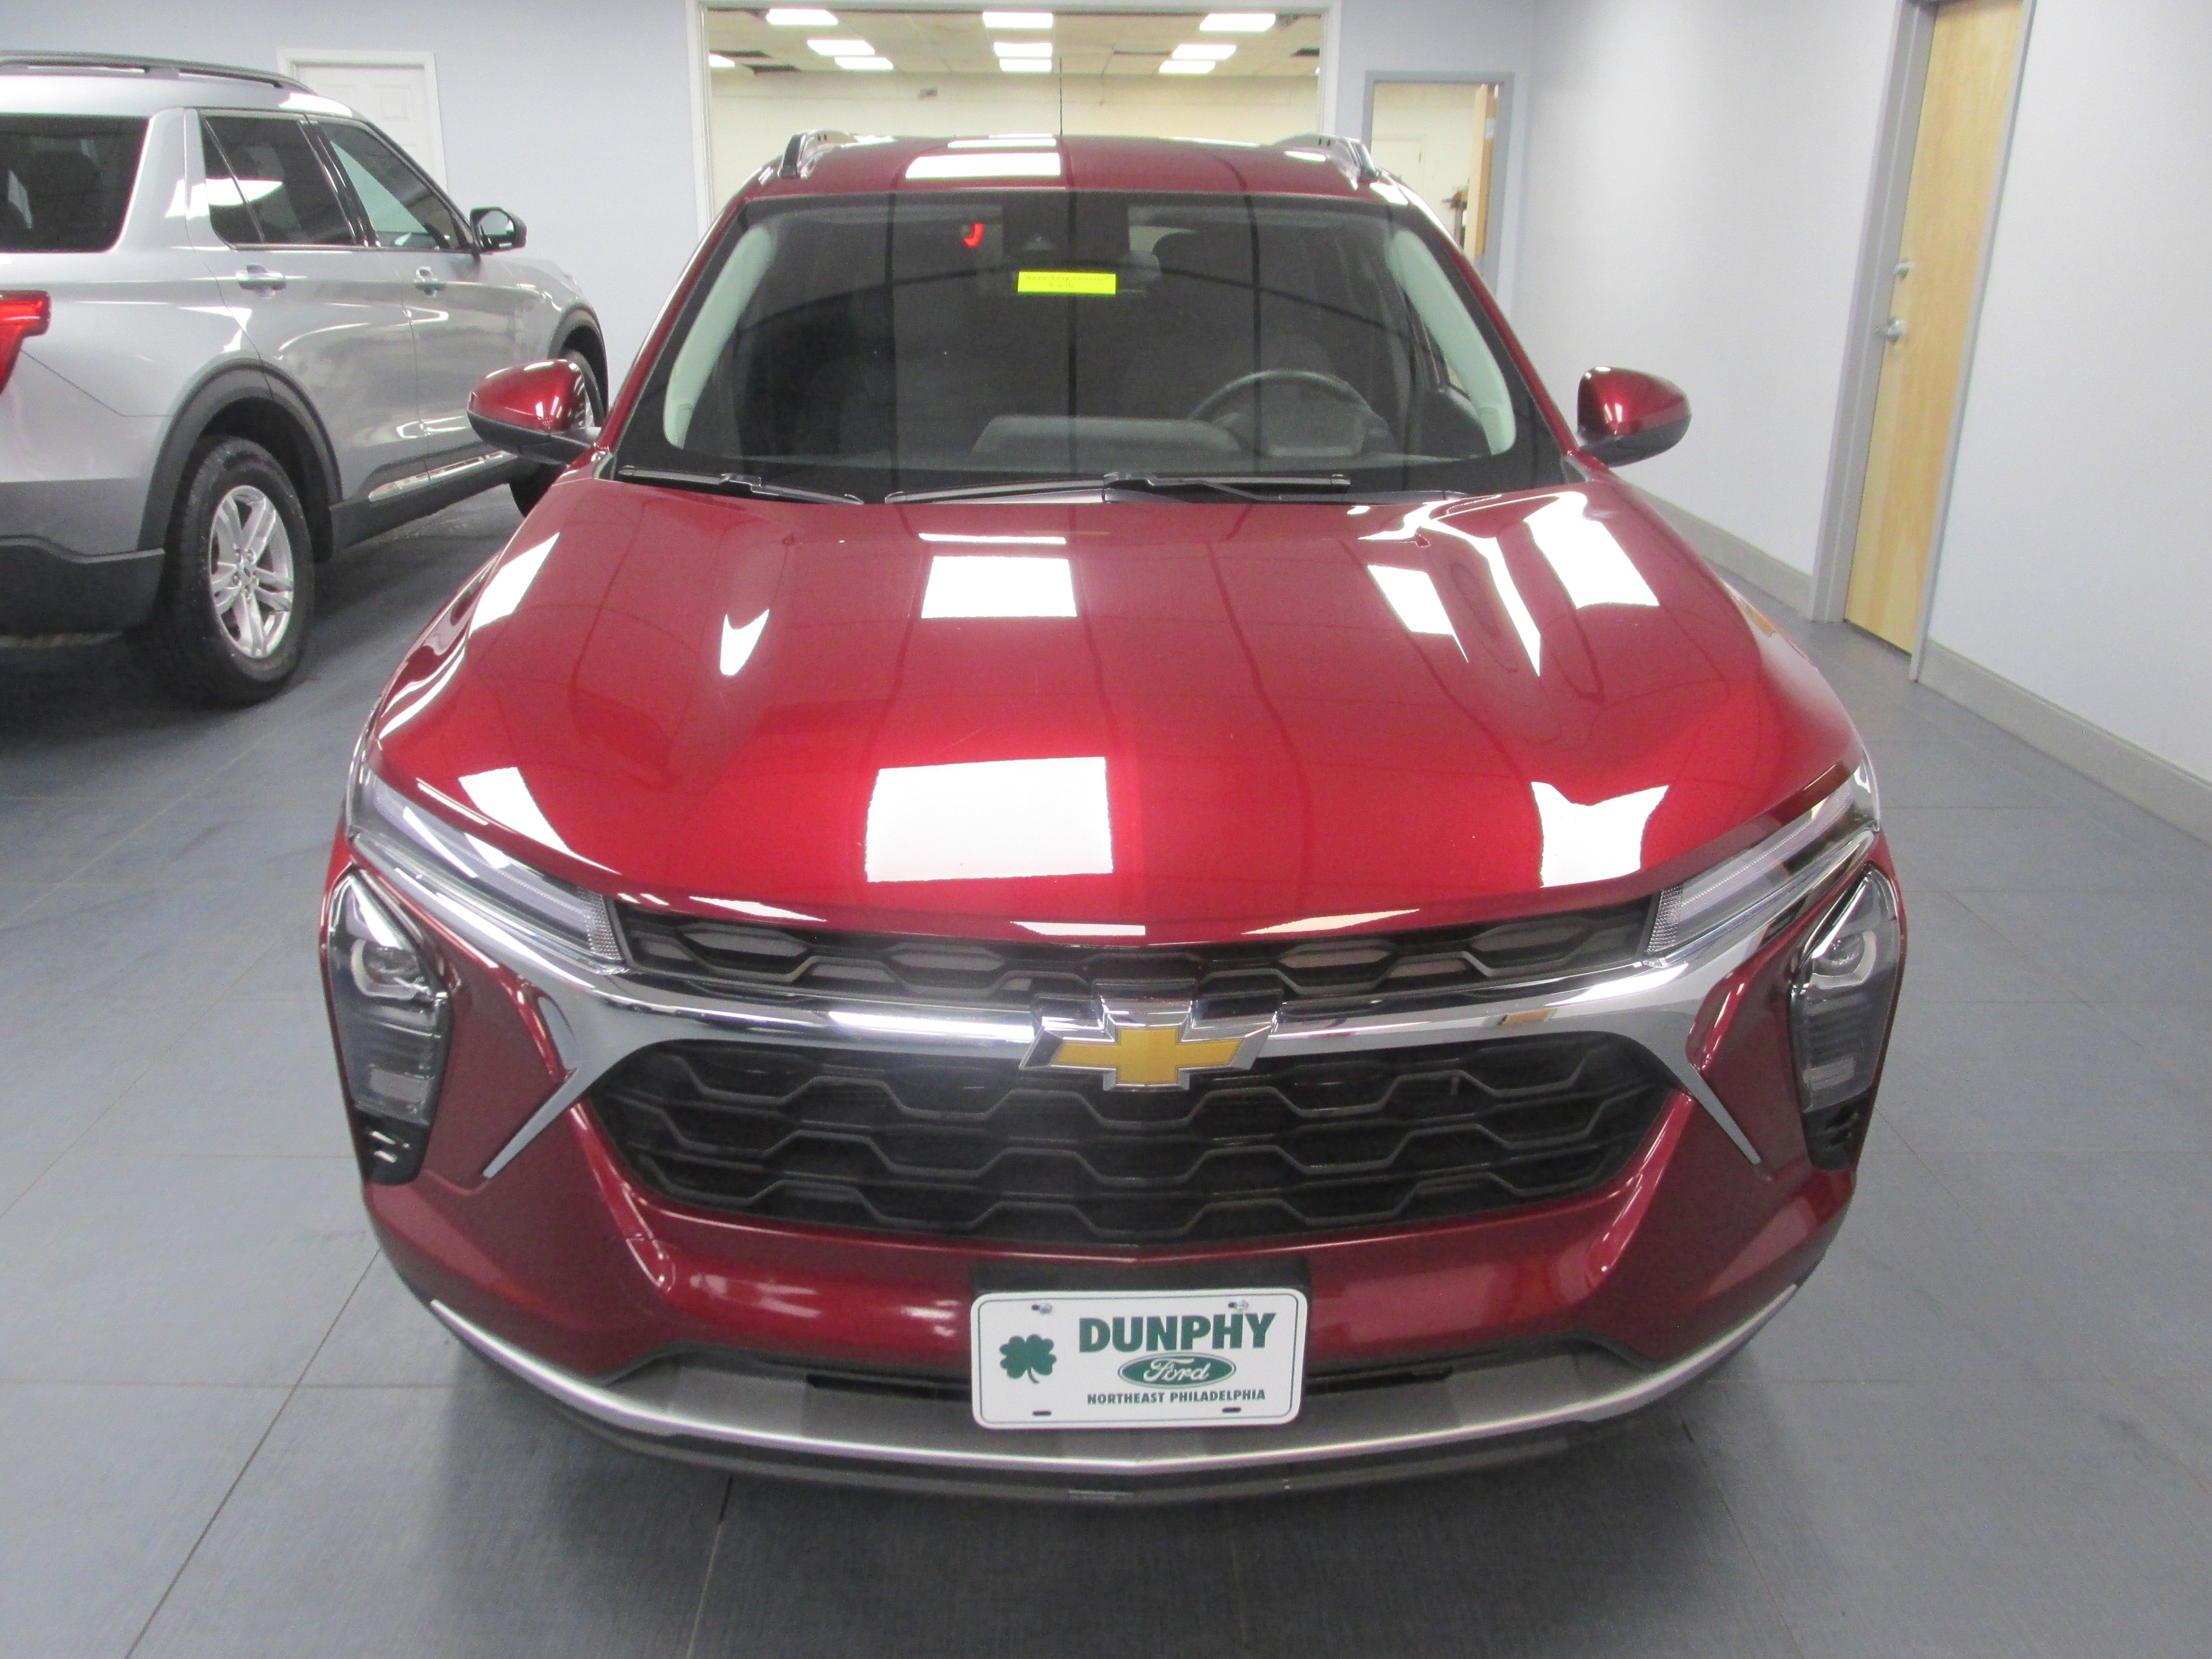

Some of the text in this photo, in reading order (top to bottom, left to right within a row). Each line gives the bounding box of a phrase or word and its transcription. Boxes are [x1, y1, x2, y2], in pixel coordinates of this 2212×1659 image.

[1079, 1312, 1276, 1353] DUNPHY
[1143, 1357, 1211, 1382] Ford
[1087, 1389, 1266, 1405] NORTHEAST PHILADELPHIA
